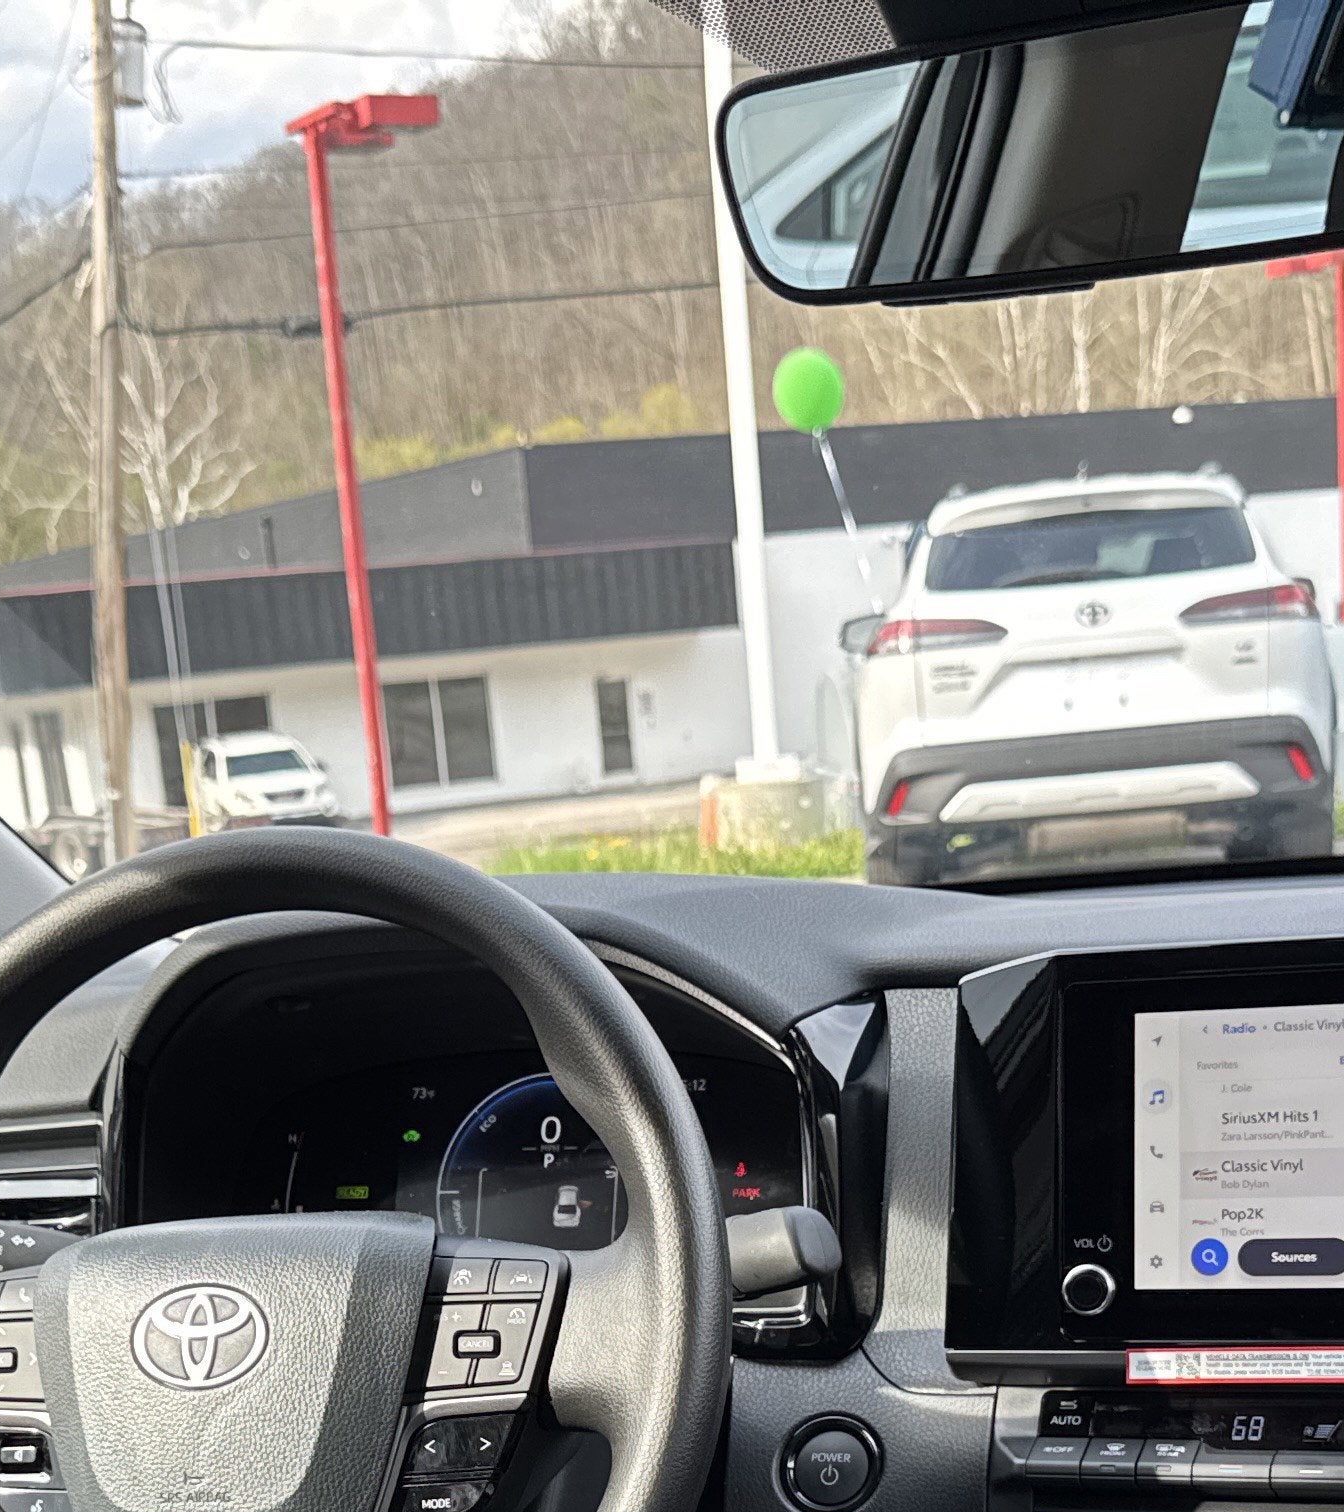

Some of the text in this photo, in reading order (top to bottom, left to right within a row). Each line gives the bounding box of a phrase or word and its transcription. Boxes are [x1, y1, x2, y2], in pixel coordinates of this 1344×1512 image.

[1222, 1023, 1256, 1035] Radio
[1273, 1020, 1314, 1033] Classic
[1221, 1109, 1319, 1125] SiriusXM Hits 1
[540, 1115, 562, 1144] 0
[543, 1152, 555, 1169] P
[1221, 1158, 1304, 1174] Classic Vinyl
[1221, 1179, 1270, 1191] Bob Dylan
[1221, 1207, 1264, 1221] Pop2K
[1073, 1238, 1095, 1249] VOL
[1271, 1251, 1318, 1264] Sources
[1050, 1414, 1082, 1427] AUTO
[1231, 1415, 1265, 1441] 68
[811, 1452, 852, 1463] POWER
[421, 1497, 453, 1510] MODE
